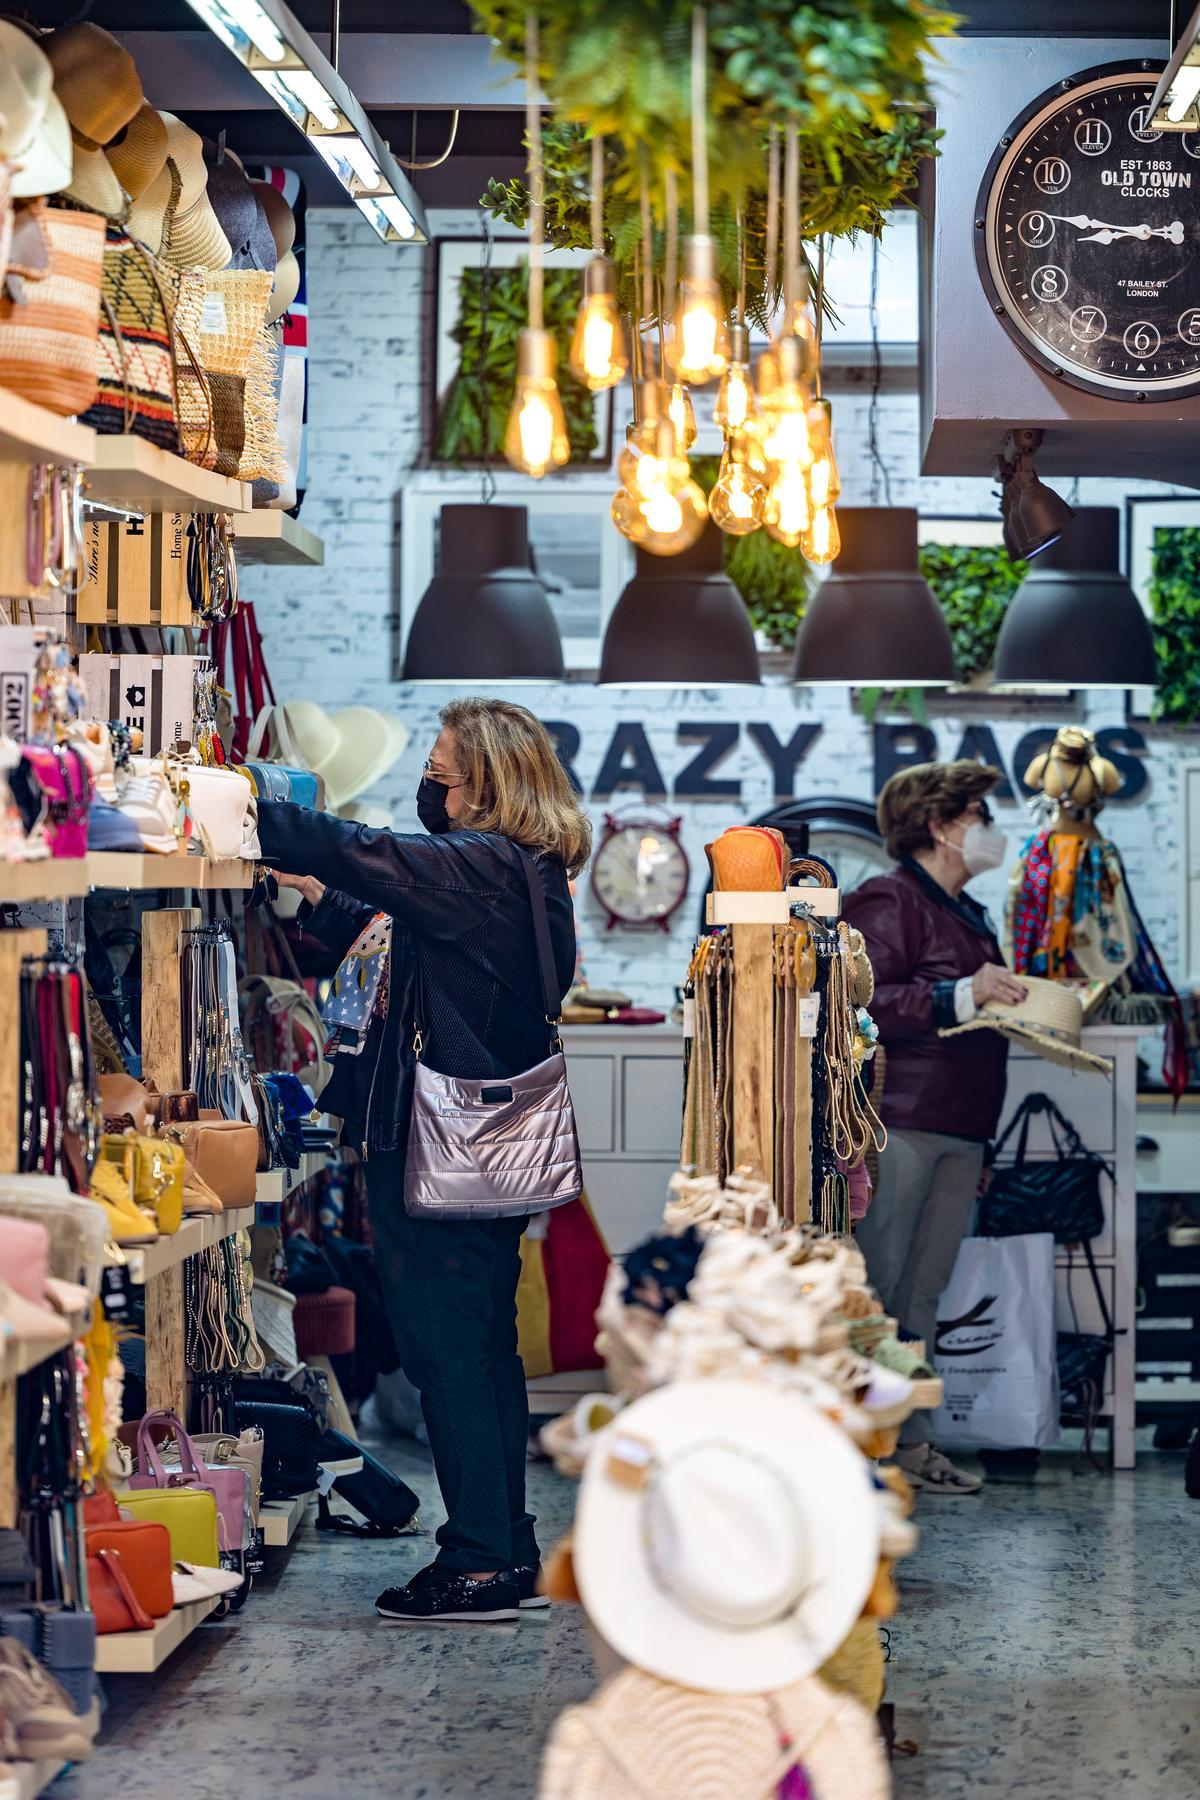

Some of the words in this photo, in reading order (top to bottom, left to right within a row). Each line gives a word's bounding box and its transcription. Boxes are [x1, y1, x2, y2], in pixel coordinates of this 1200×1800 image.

[1081, 122, 1104, 145] 11
[1040, 161, 1065, 185] 10
[1120, 159, 1143, 170] EST
[1146, 160, 1172, 171] 1863
[1101, 170, 1135, 186] OLD
[1140, 171, 1192, 189] TOWN
[1121, 186, 1170, 198] CLOCKS
[1028, 214, 1045, 240] 9
[1041, 269, 1058, 293] 8
[1127, 280, 1155, 288] BAILEY
[1081, 309, 1097, 334] 7
[1188, 314, 1200, 337] 5
[1134, 325, 1150, 351] 6
[170, 528, 182, 559] Home
[172, 721, 182, 744] ome
